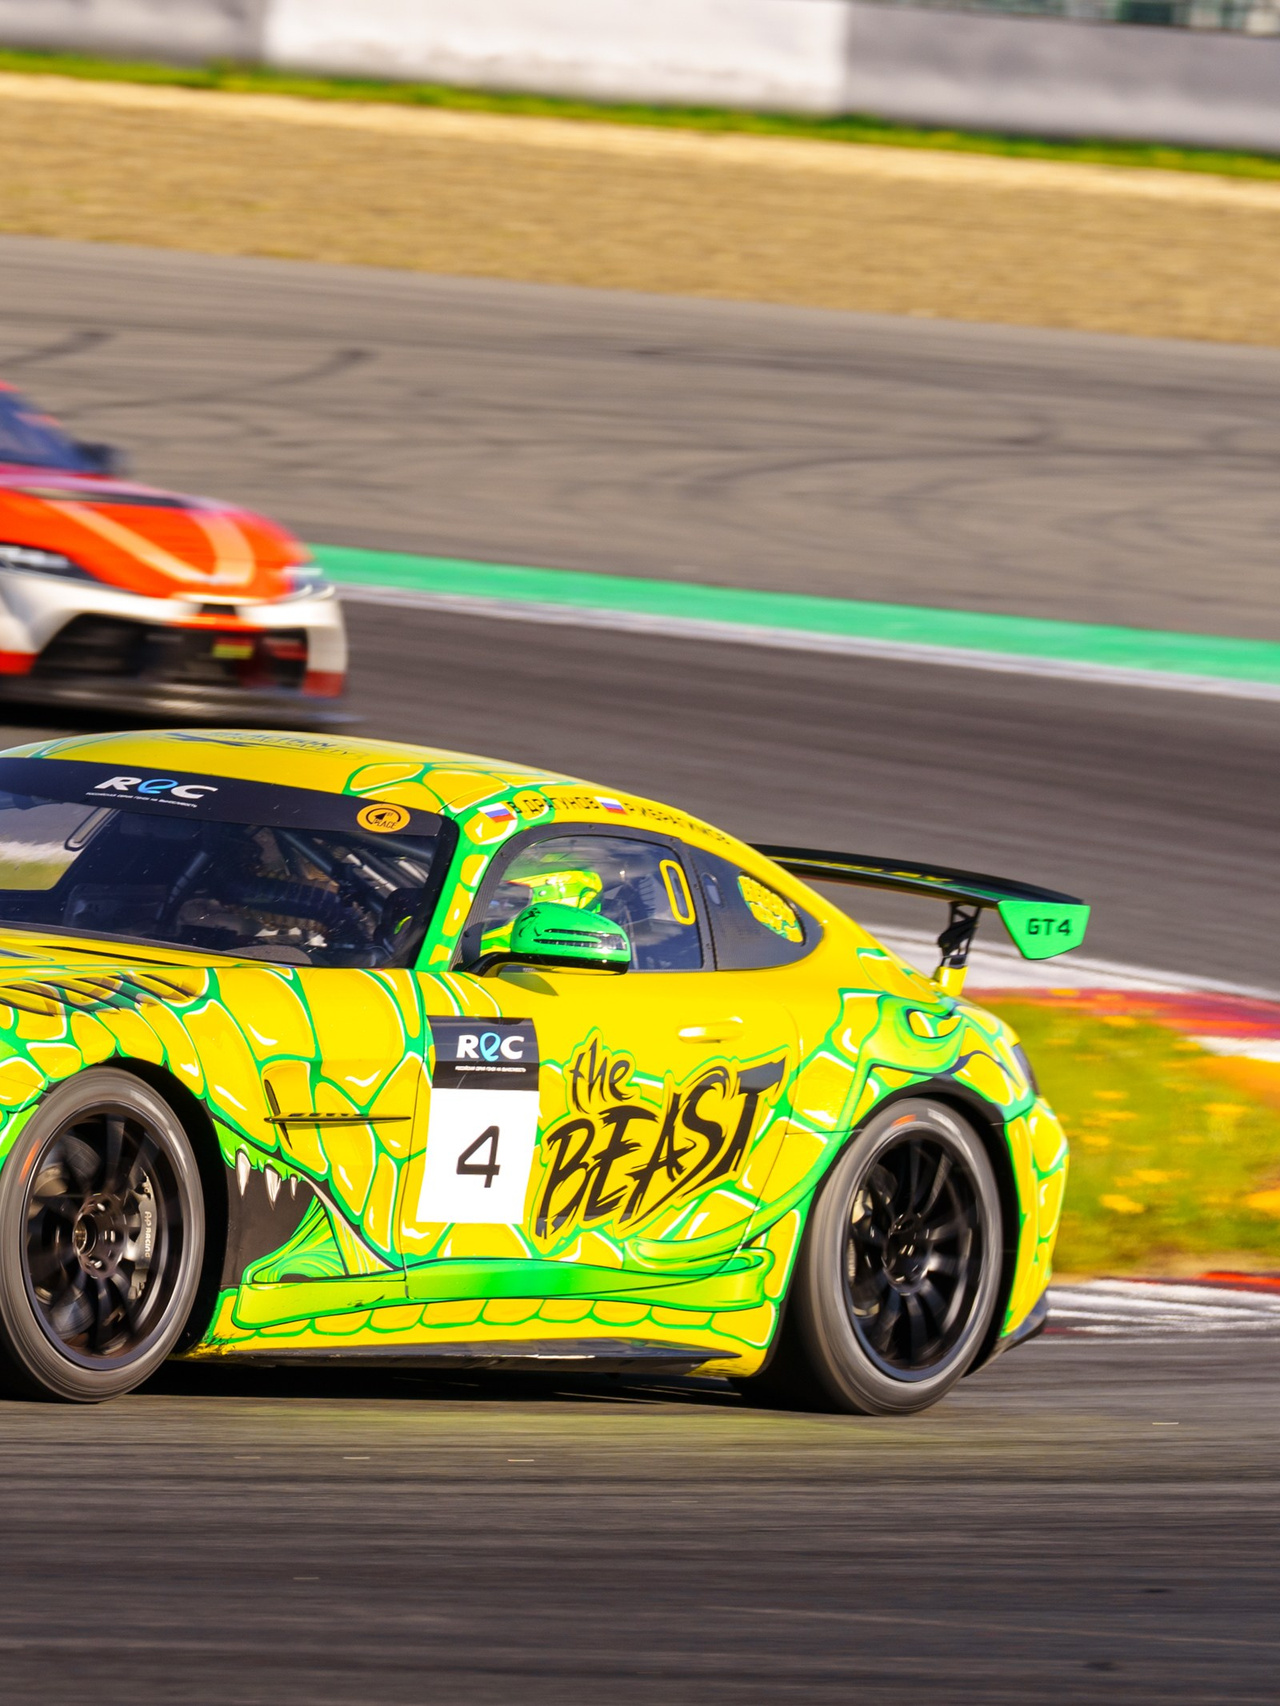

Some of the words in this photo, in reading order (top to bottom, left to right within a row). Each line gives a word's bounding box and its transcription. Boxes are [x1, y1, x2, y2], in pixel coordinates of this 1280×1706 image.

[1027, 917, 1071, 936] GT4
[569, 1036, 631, 1114] the
[455, 1124, 501, 1189] 4
[535, 1057, 787, 1240] BEAST
[144, 1210, 152, 1227] AP
